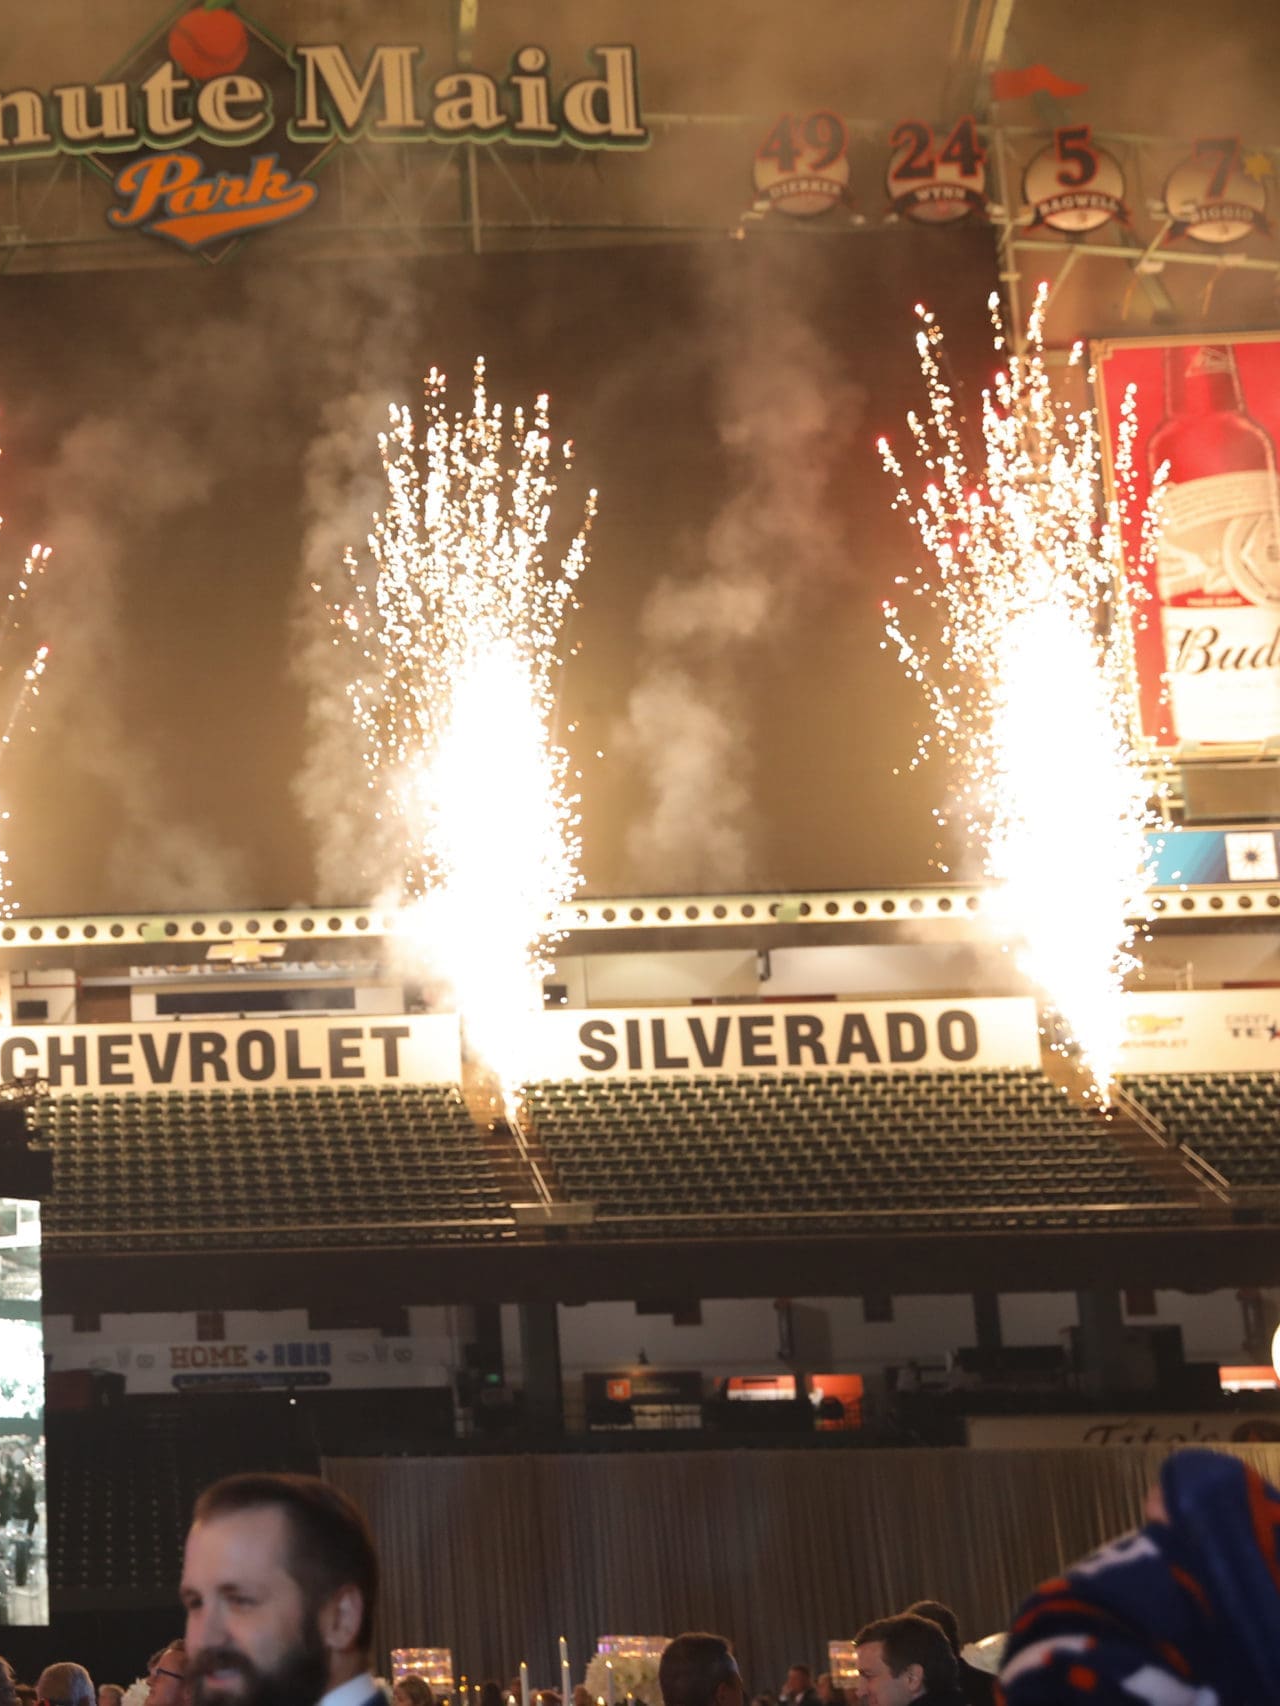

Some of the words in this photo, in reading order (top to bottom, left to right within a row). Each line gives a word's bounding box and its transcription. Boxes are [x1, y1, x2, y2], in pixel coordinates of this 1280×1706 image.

[294, 42, 646, 140] Maid
[756, 109, 849, 173] 49
[889, 115, 987, 180] 24
[1054, 126, 1098, 187] 5
[1193, 134, 1240, 200] 7
[111, 153, 315, 228] Park
[1039, 194, 1119, 215] BAGWELL
[0, 1026, 411, 1086] CHEVROLET
[578, 1010, 980, 1072] SILVERADO
[170, 1343, 249, 1370] HOME
